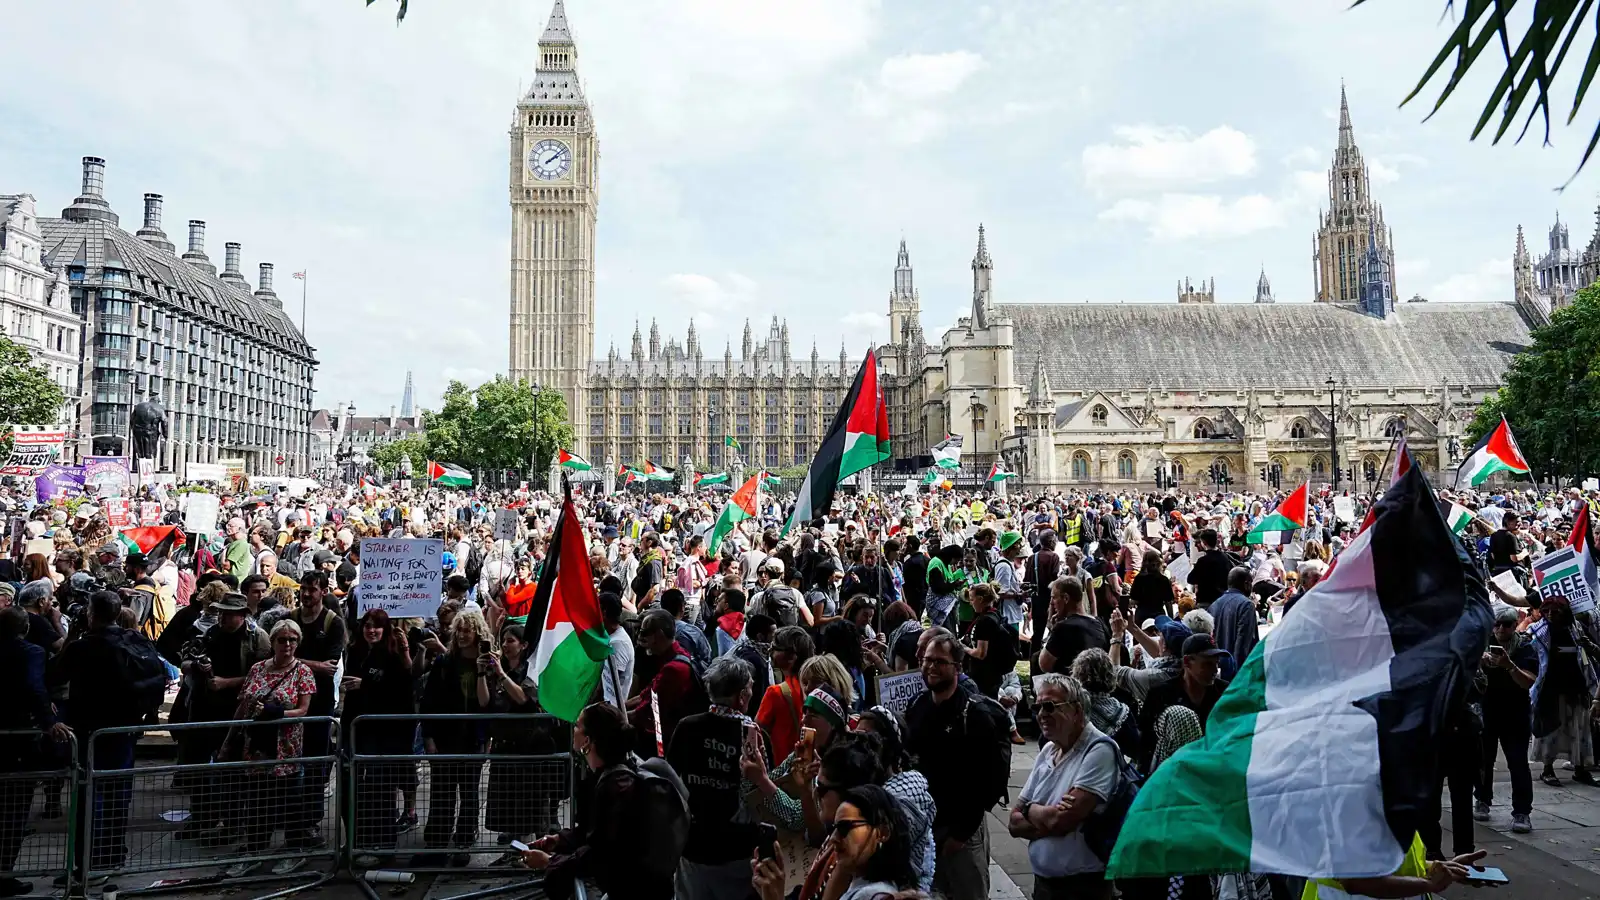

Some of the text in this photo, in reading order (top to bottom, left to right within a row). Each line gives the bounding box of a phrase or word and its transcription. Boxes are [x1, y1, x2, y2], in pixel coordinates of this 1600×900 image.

[365, 543, 436, 555] STARMER IS
[363, 557, 428, 570] WAITING FOR
[361, 571, 383, 580] GAZA
[388, 572, 400, 582] TO
[401, 572, 412, 581] BE
[361, 582, 373, 590] SO
[1540, 572, 1585, 600] FREE
[401, 591, 432, 600] GENOCIDE
[884, 678, 903, 688] SHAME
[704, 738, 737, 758] stop
[708, 756, 732, 773] the
